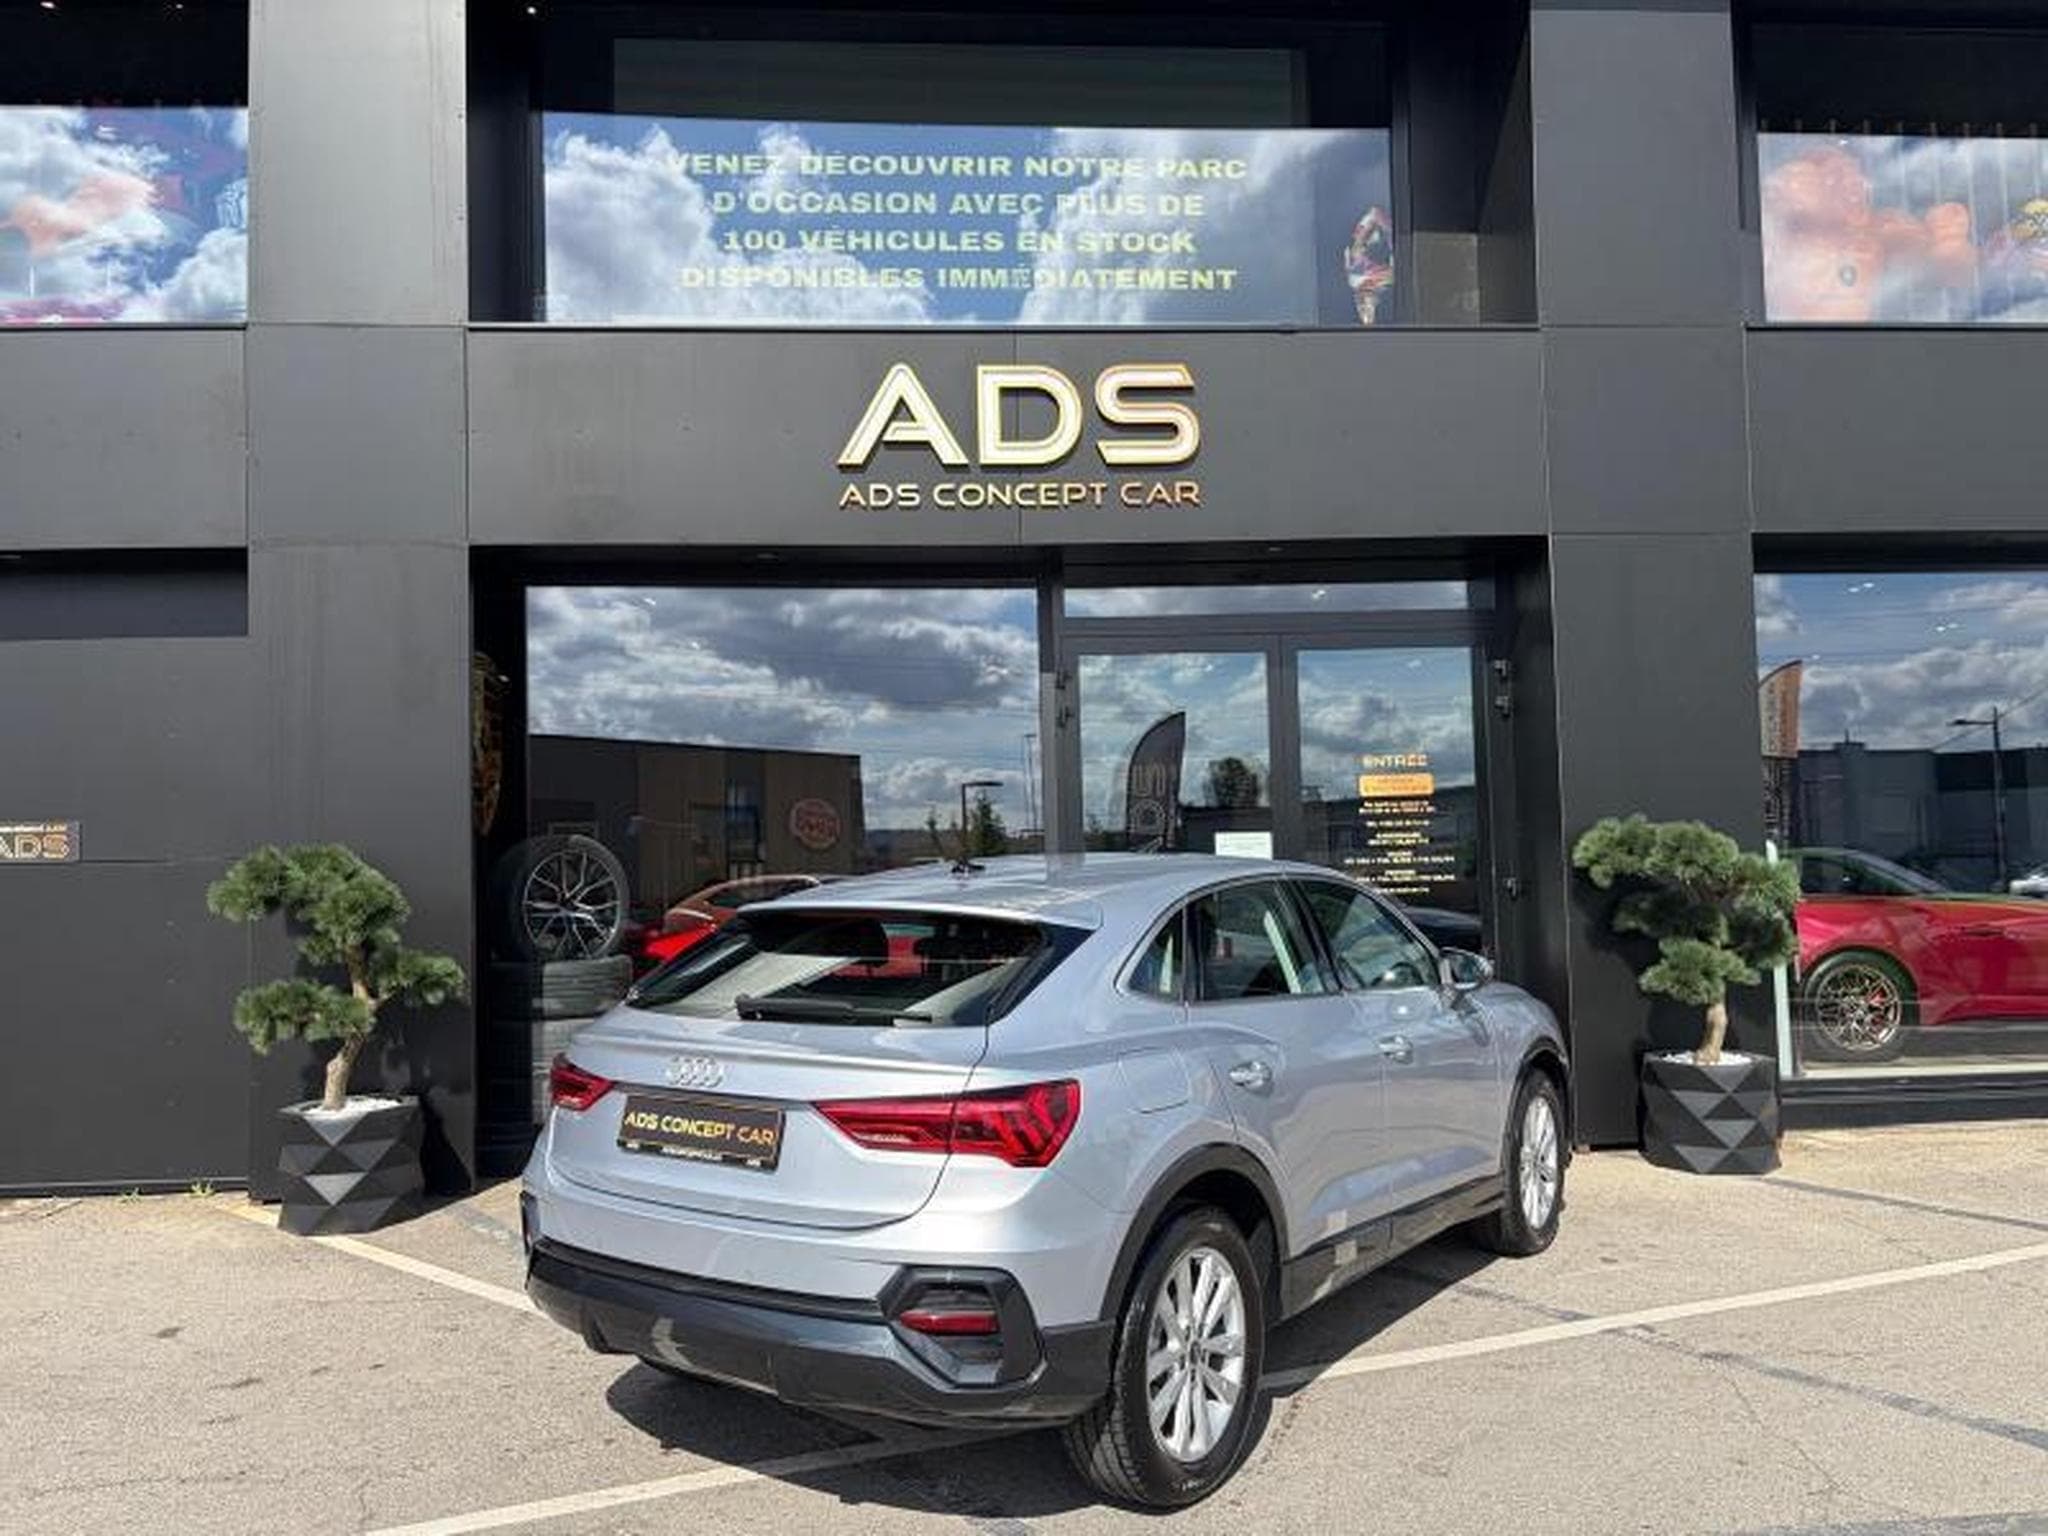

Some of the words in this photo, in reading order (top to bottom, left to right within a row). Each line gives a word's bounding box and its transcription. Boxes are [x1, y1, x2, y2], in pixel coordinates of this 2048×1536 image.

[800, 150, 1011, 177] DÉCOUVRIR
[1024, 157, 1146, 178] NOTRE
[1156, 159, 1247, 179] PARC
[712, 191, 936, 214] D'OCCASION
[949, 194, 1044, 215] AVEC
[1056, 194, 1147, 215] PLUS
[1159, 195, 1205, 216] DE
[723, 229, 786, 250] 100
[799, 225, 1005, 252] VÉHICULES
[1016, 231, 1063, 252] EN
[1077, 231, 1197, 253] STOCK
[680, 267, 925, 288] DISPONIBLES
[938, 264, 1238, 289] IMMÉDIATEMENT
[836, 361, 1200, 468] ADS
[838, 482, 921, 509] ADS
[932, 482, 1107, 508] CONCEPT
[1119, 480, 1202, 508] CAR
[624, 1110, 659, 1130] ADS
[660, 1114, 735, 1141] CONCEPT
[736, 1125, 775, 1146] CAR
